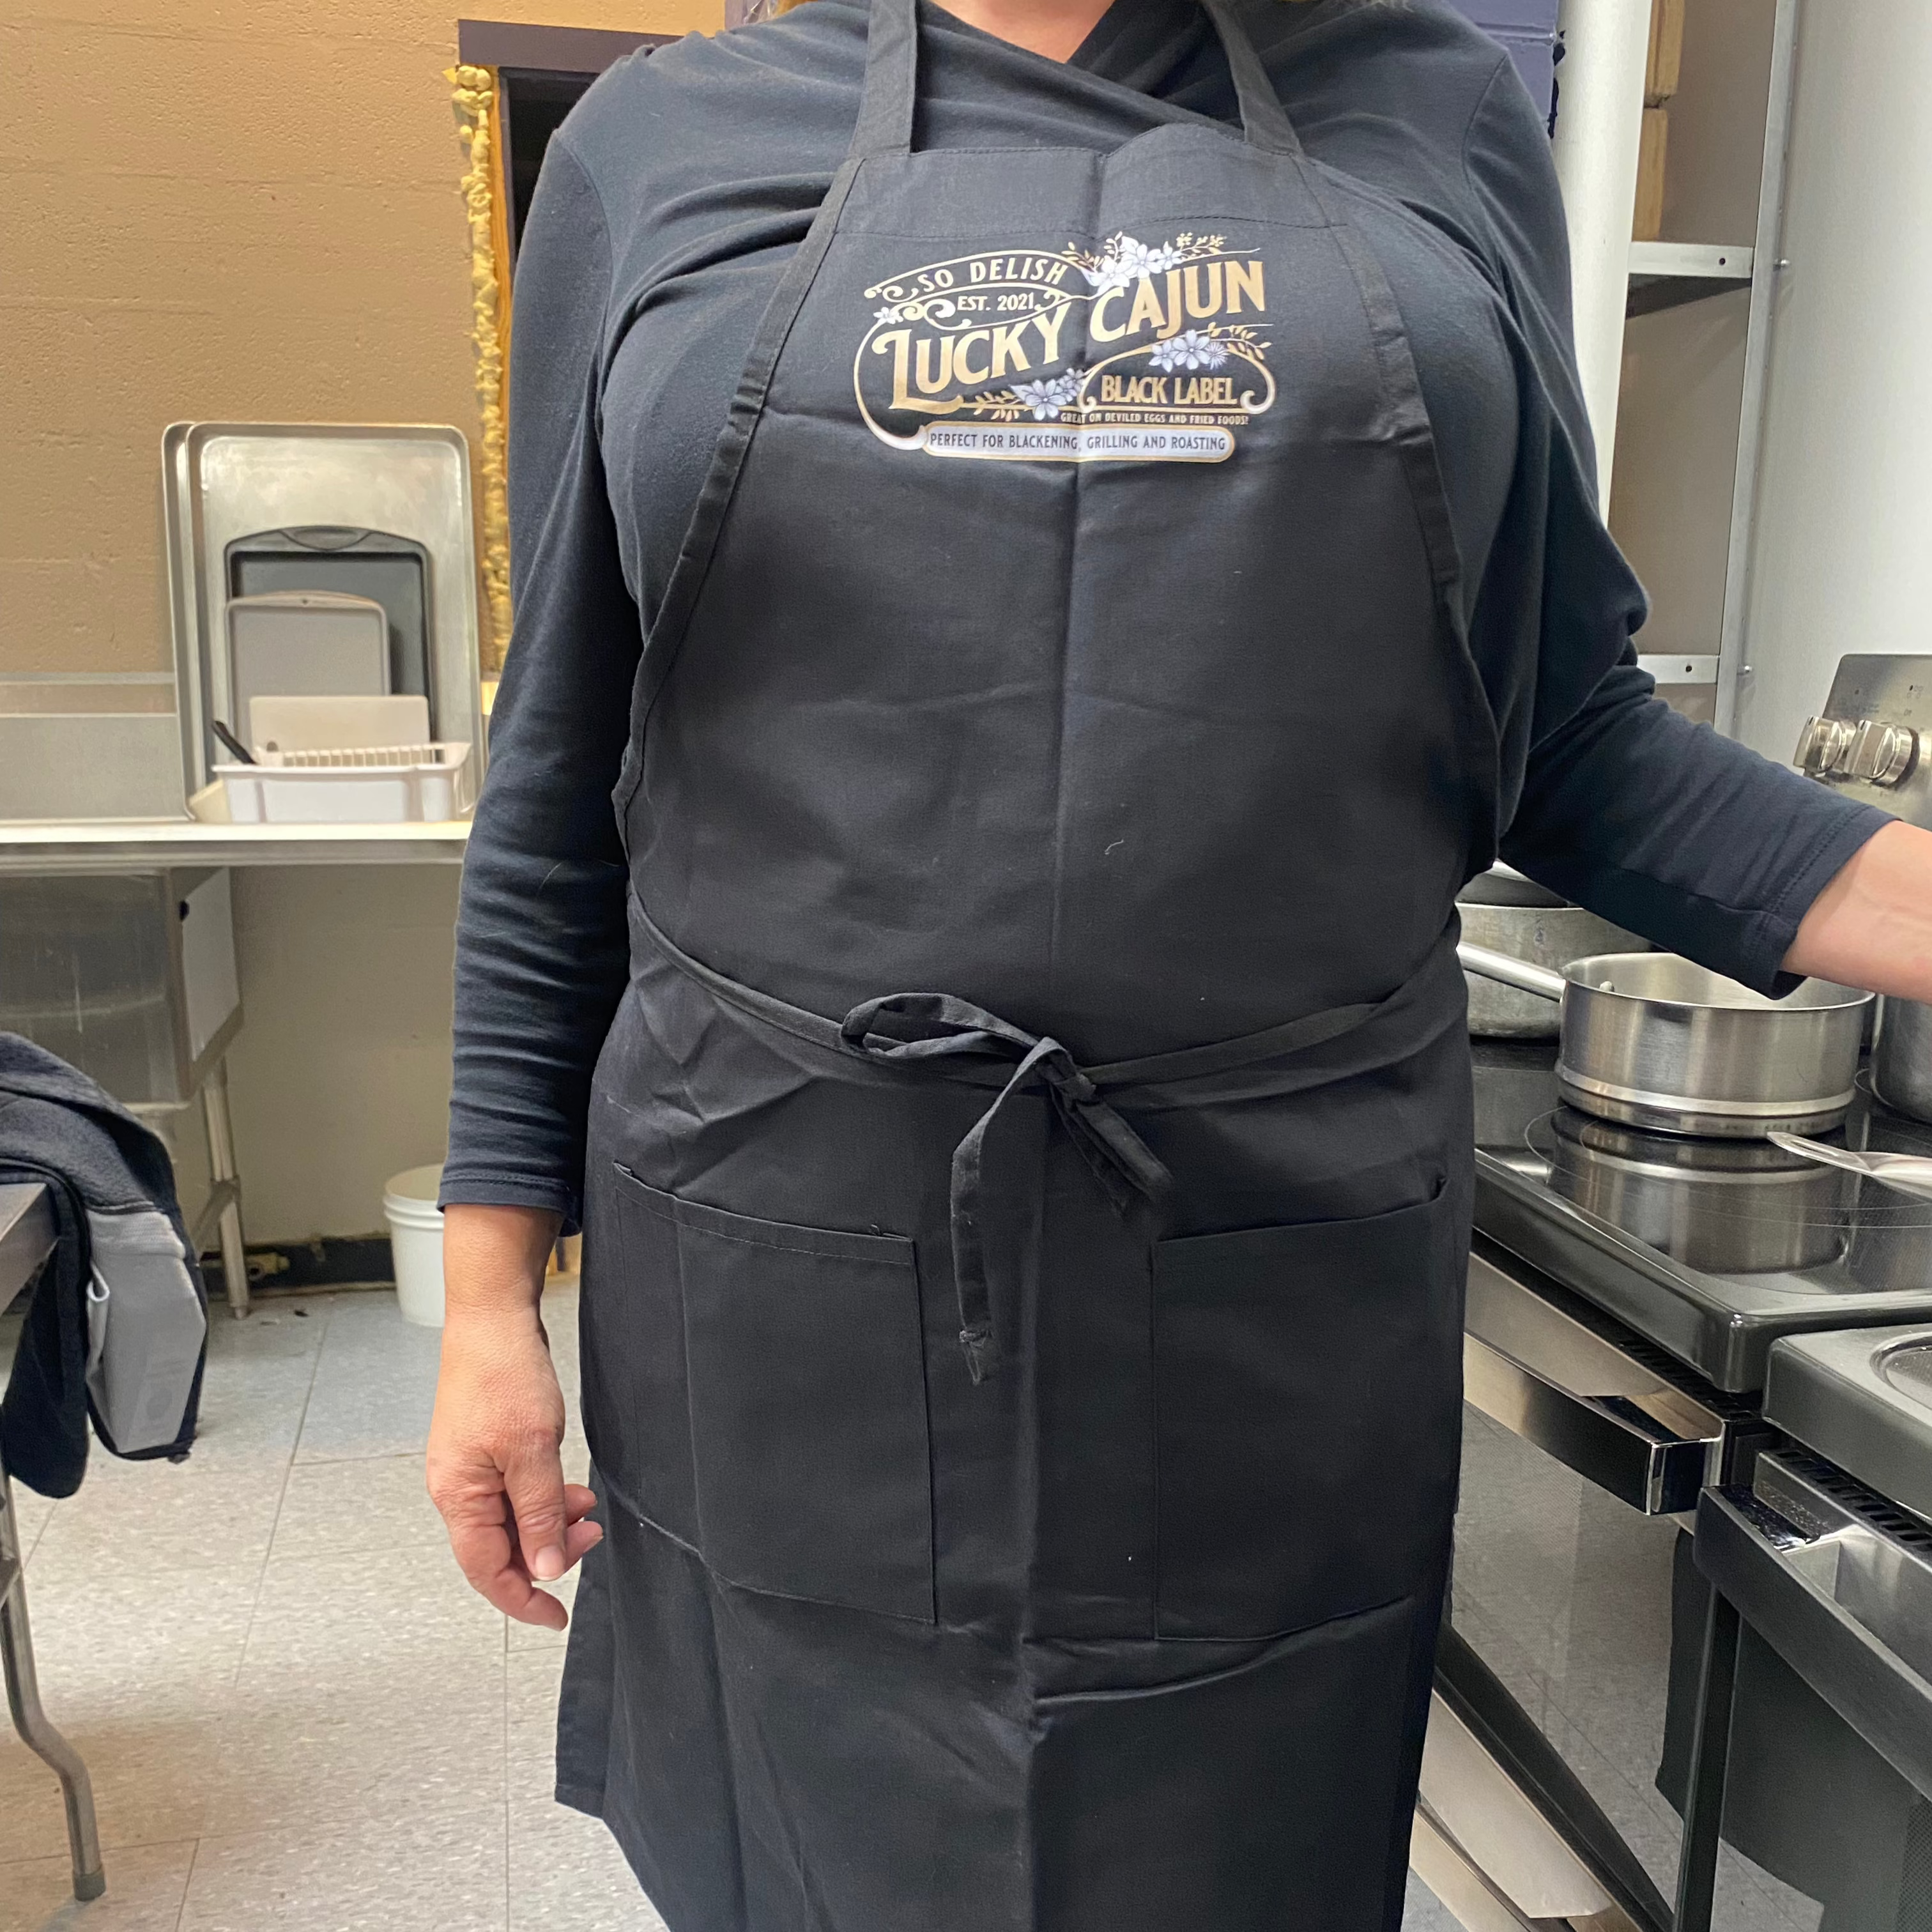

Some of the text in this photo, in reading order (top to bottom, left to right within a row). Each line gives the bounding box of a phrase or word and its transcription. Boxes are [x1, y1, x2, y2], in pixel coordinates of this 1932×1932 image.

[917, 257, 1069, 292] SO DELISH
[957, 292, 1034, 311] EST. 2021
[871, 261, 1264, 415] LUCKY CAJUN
[1101, 375, 1238, 404] BLACK LABEL
[1061, 412, 1085, 424] GREAT
[1089, 412, 1101, 423] ON
[1105, 413, 1140, 423] DEVILED
[1144, 413, 1166, 424] EGGS
[1169, 414, 1187, 424] AND
[1190, 414, 1214, 424] FRIED
[930, 433, 978, 447] PERFECT
[983, 434, 1004, 447] FOR
[1087, 435, 1138, 449] GRILLING
[1143, 436, 1167, 450] AND
[1171, 437, 1225, 450] ROASTING
